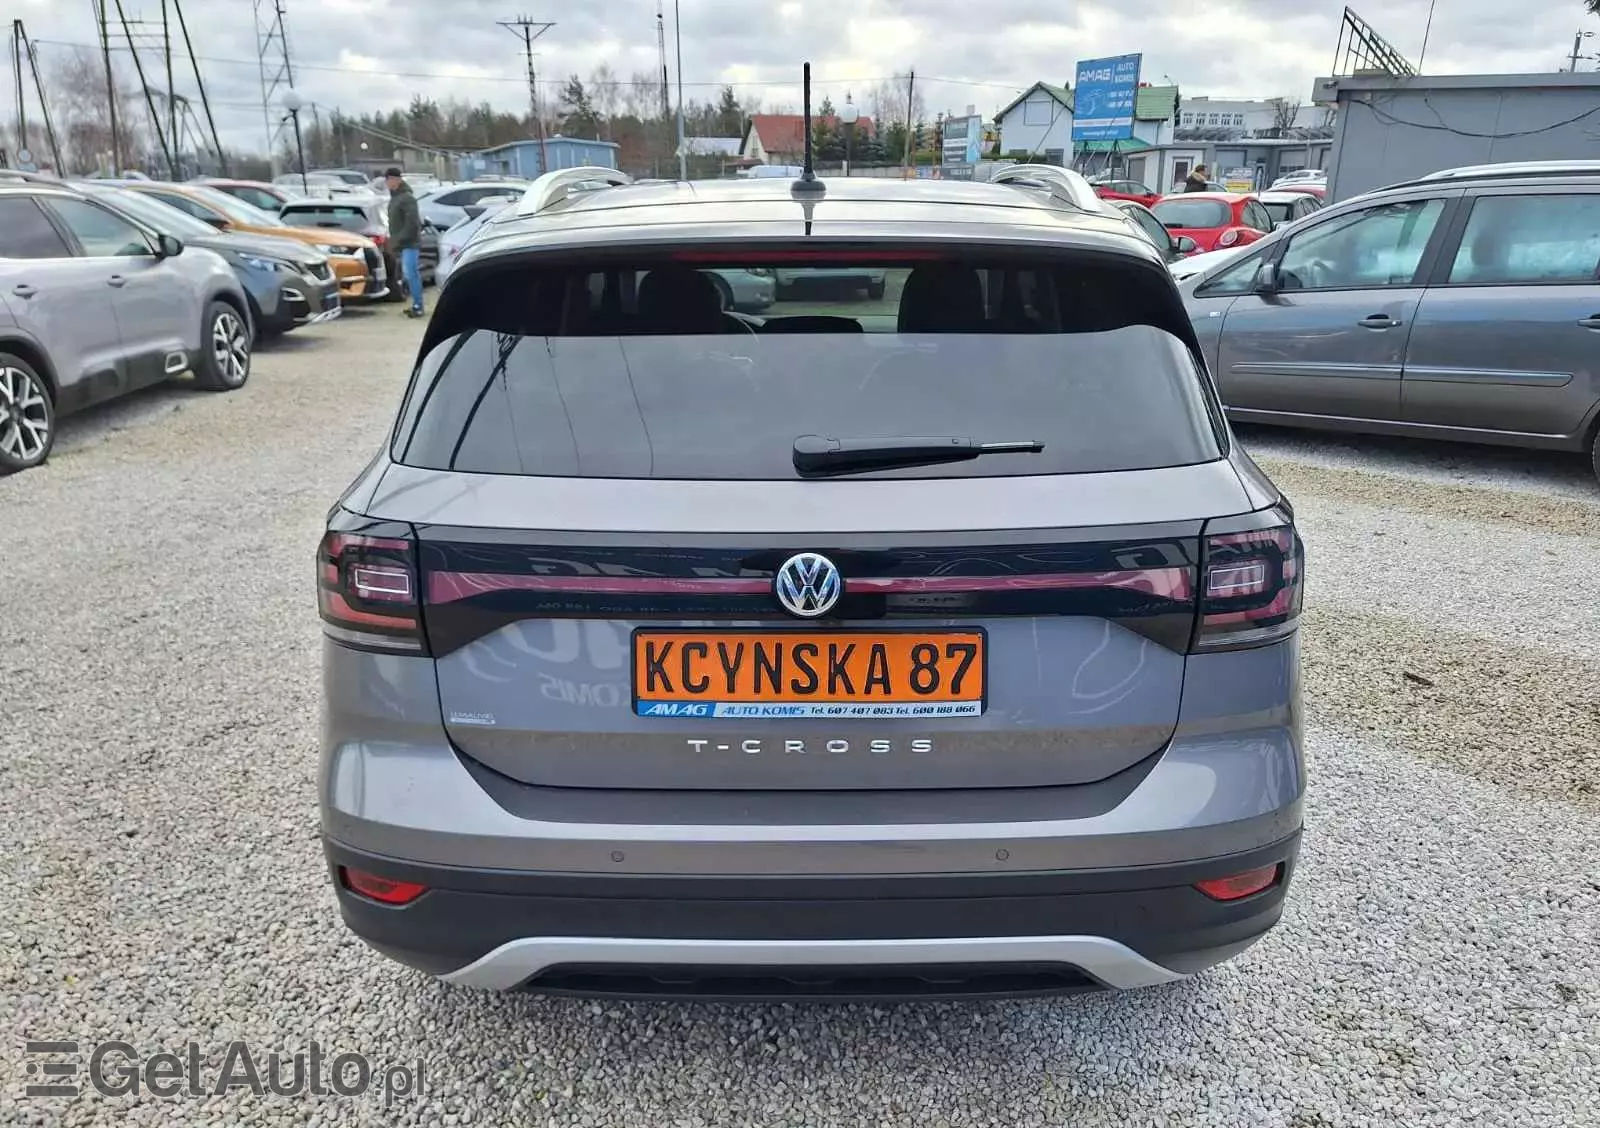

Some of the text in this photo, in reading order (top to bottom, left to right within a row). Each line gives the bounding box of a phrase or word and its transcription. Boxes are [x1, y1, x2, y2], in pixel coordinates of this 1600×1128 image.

[1079, 68, 1111, 82] AMAG
[646, 641, 977, 695] KCYNSKA 87
[645, 703, 709, 716] AMAG
[722, 705, 758, 715] AUTO
[828, 705, 848, 714] 607
[851, 705, 871, 715] 407
[873, 705, 893, 715] 083
[913, 705, 934, 714] 600
[936, 705, 953, 714] 188
[955, 705, 976, 713] 066
[687, 739, 933, 753] T-CROSS
